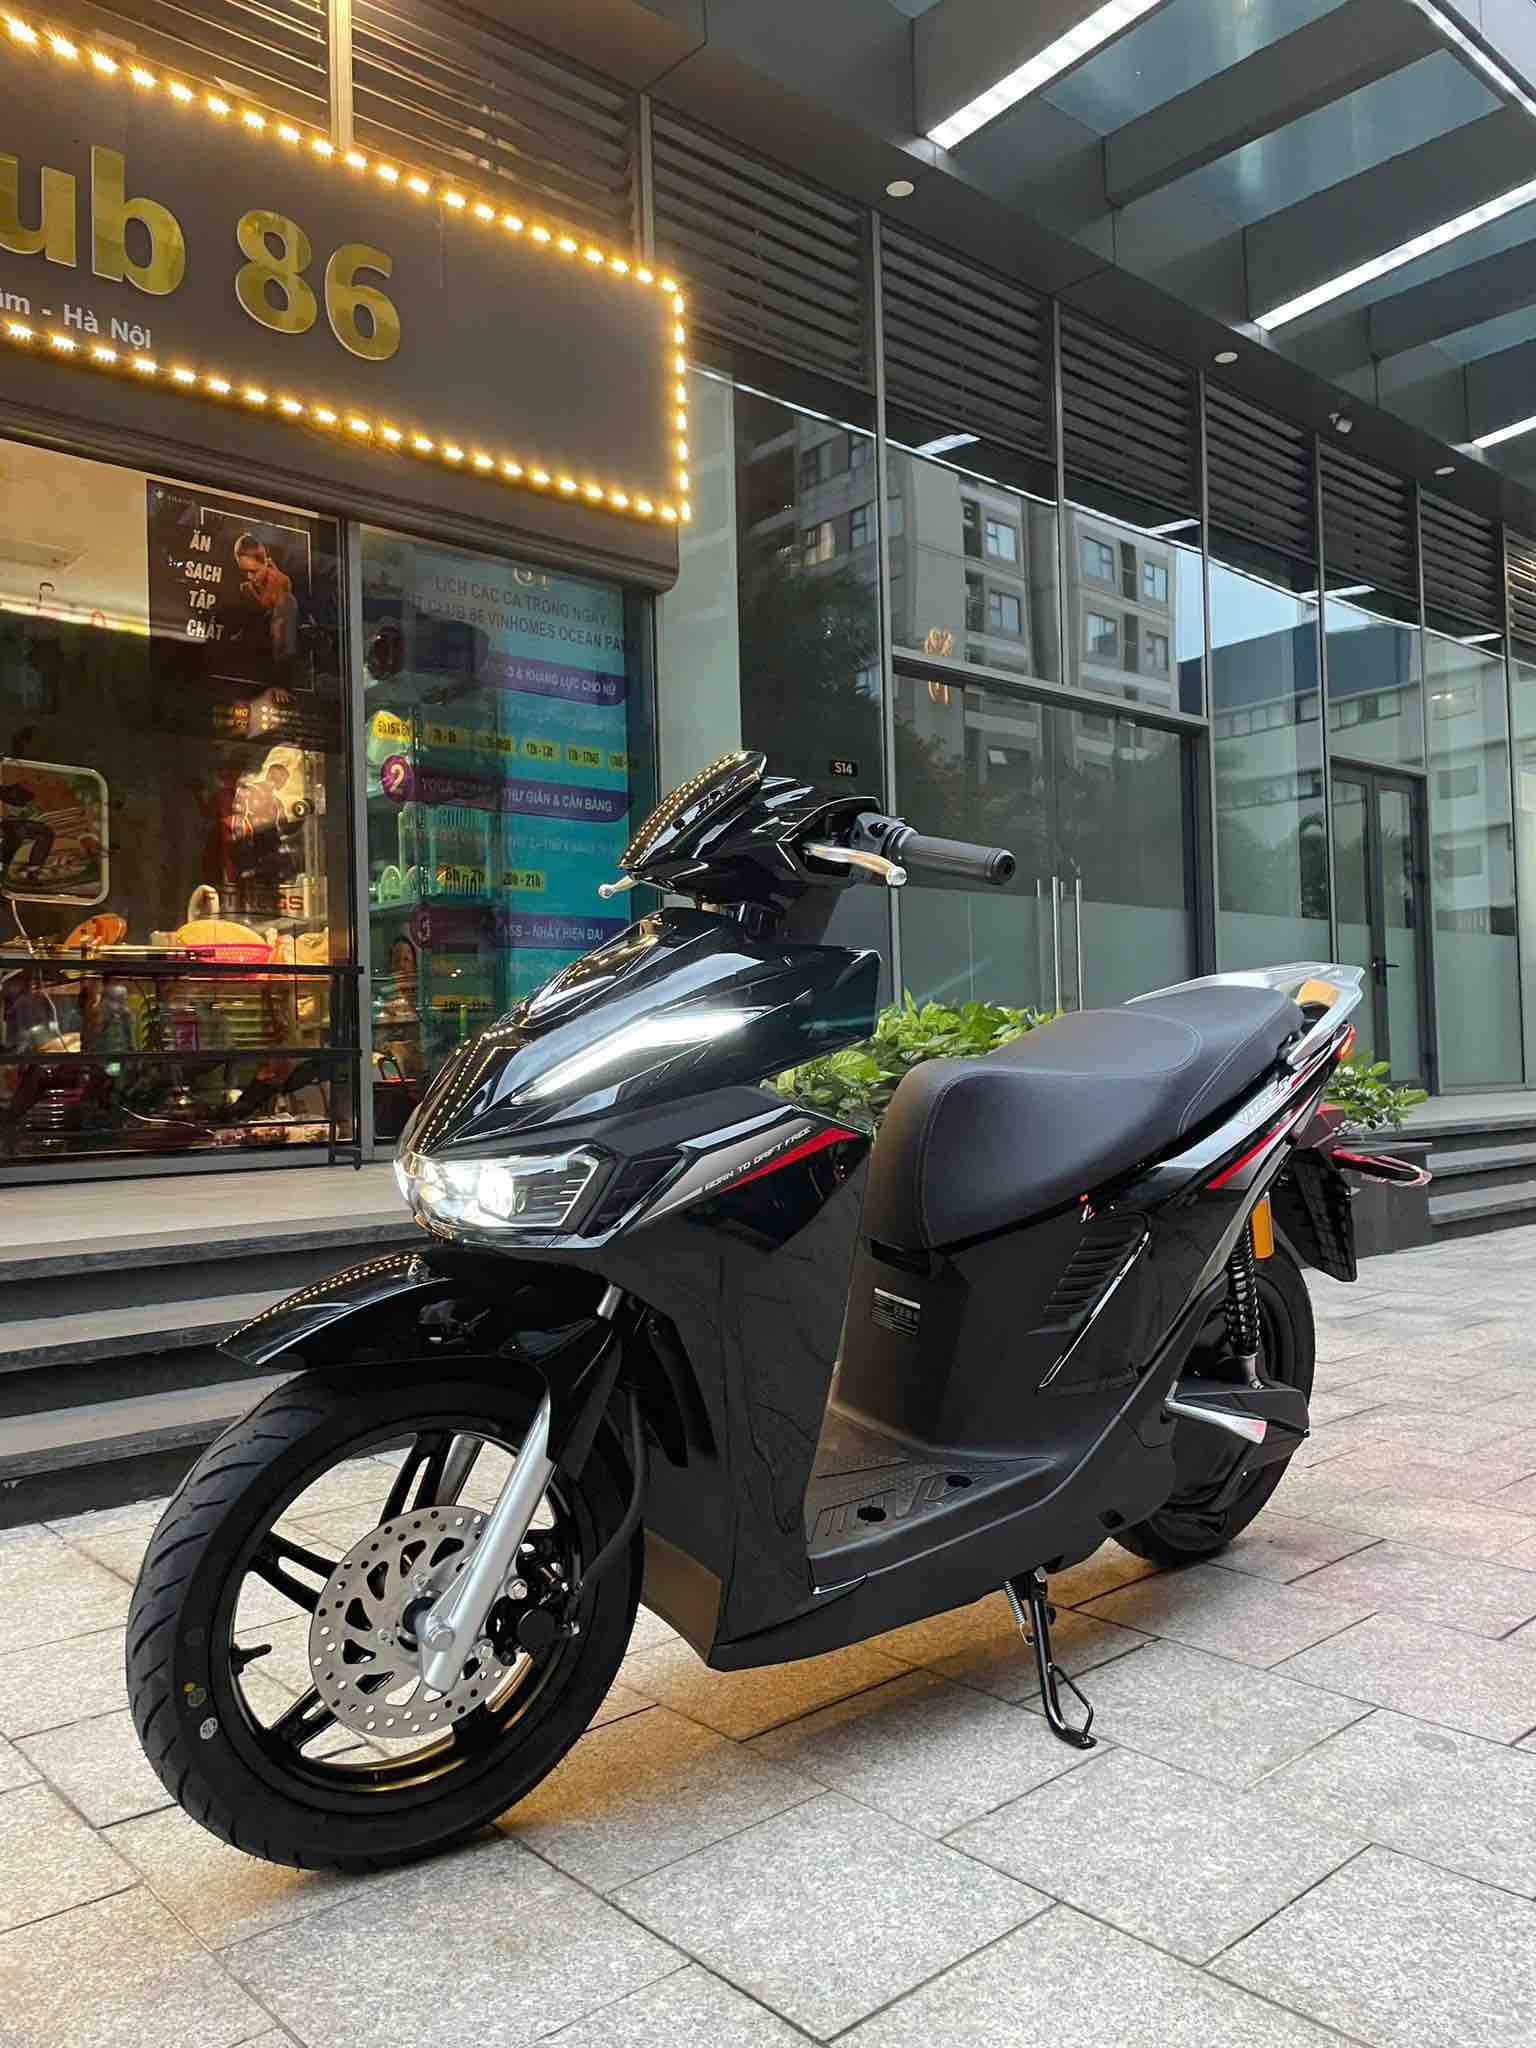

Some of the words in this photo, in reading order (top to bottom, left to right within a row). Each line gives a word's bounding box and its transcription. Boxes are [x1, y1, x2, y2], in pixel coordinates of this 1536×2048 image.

[235, 209, 400, 361] 86
[63, 303, 99, 335] Hà
[111, 316, 152, 351] Nội
[189, 529, 212, 553] ĂN
[184, 560, 222, 584] SẠCH
[189, 588, 216, 614] TẬP
[186, 615, 225, 641] CHẤT
[488, 613, 556, 640] VINHOMES
[558, 626, 602, 649] OCEAN
[389, 764, 405, 793] 2
